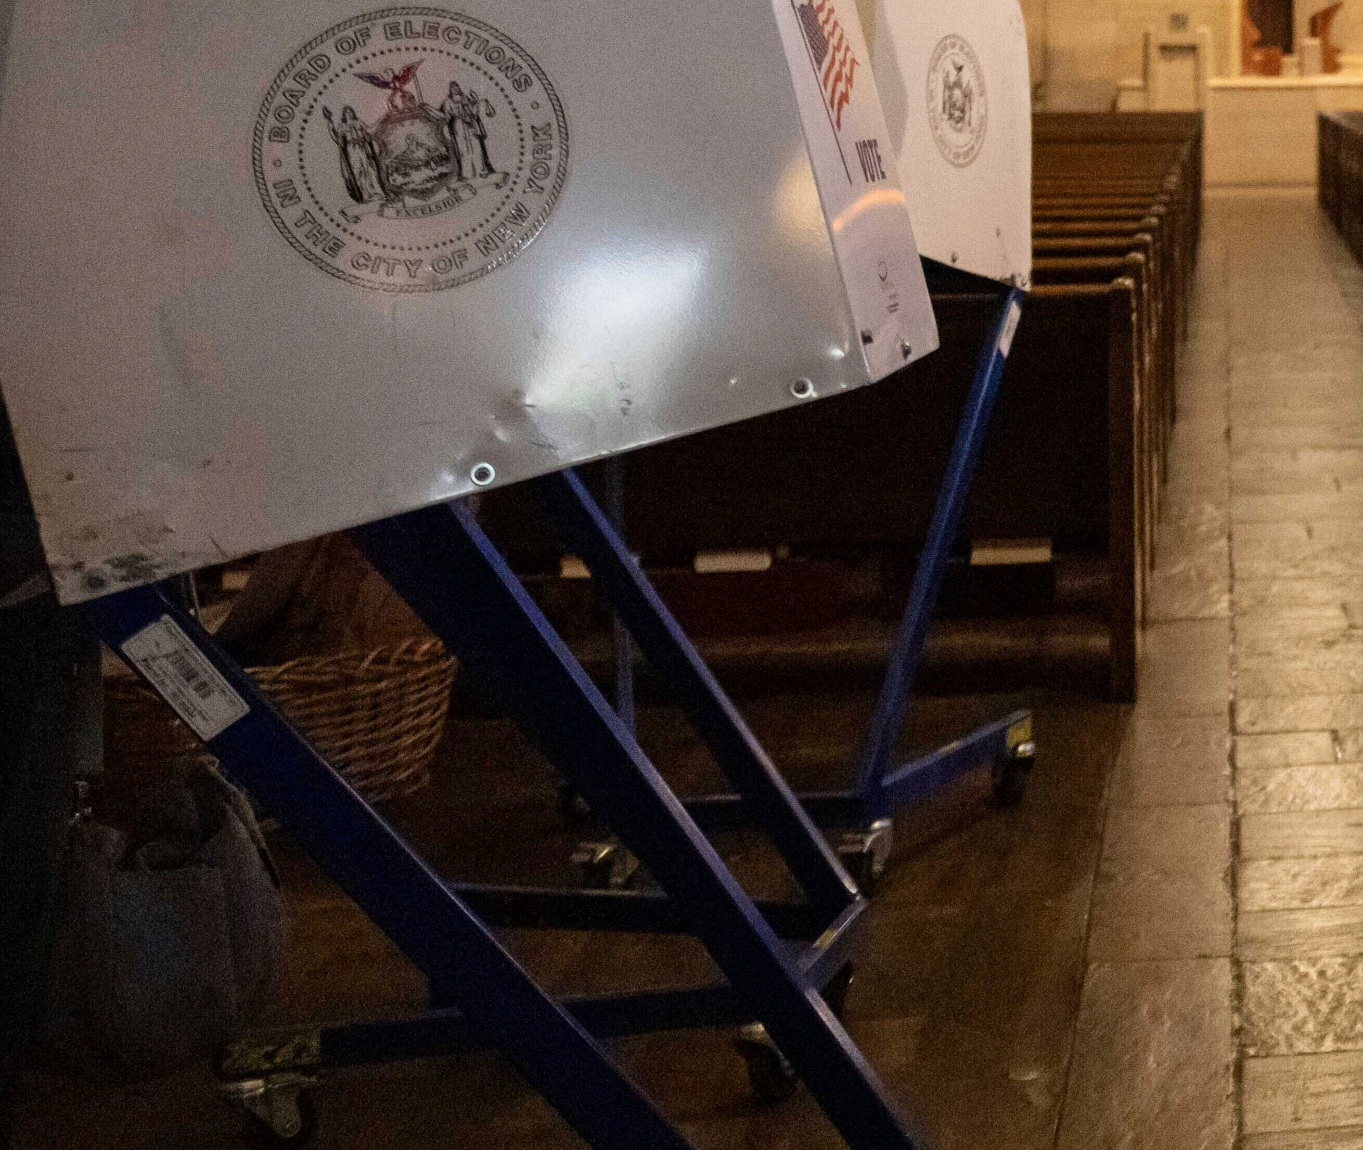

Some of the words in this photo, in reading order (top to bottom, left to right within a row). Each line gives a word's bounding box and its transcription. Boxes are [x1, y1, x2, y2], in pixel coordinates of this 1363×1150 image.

[268, 55, 332, 143] BOARD
[335, 27, 373, 56] OF
[384, 20, 534, 93] ELECTIONS
[272, 178, 301, 209] IN
[294, 209, 345, 259] THE
[350, 251, 423, 278] CITY
[431, 250, 469, 275] OF
[475, 202, 532, 258] NEW
[523, 122, 553, 195] YORK
[855, 139, 886, 182] VOTE
